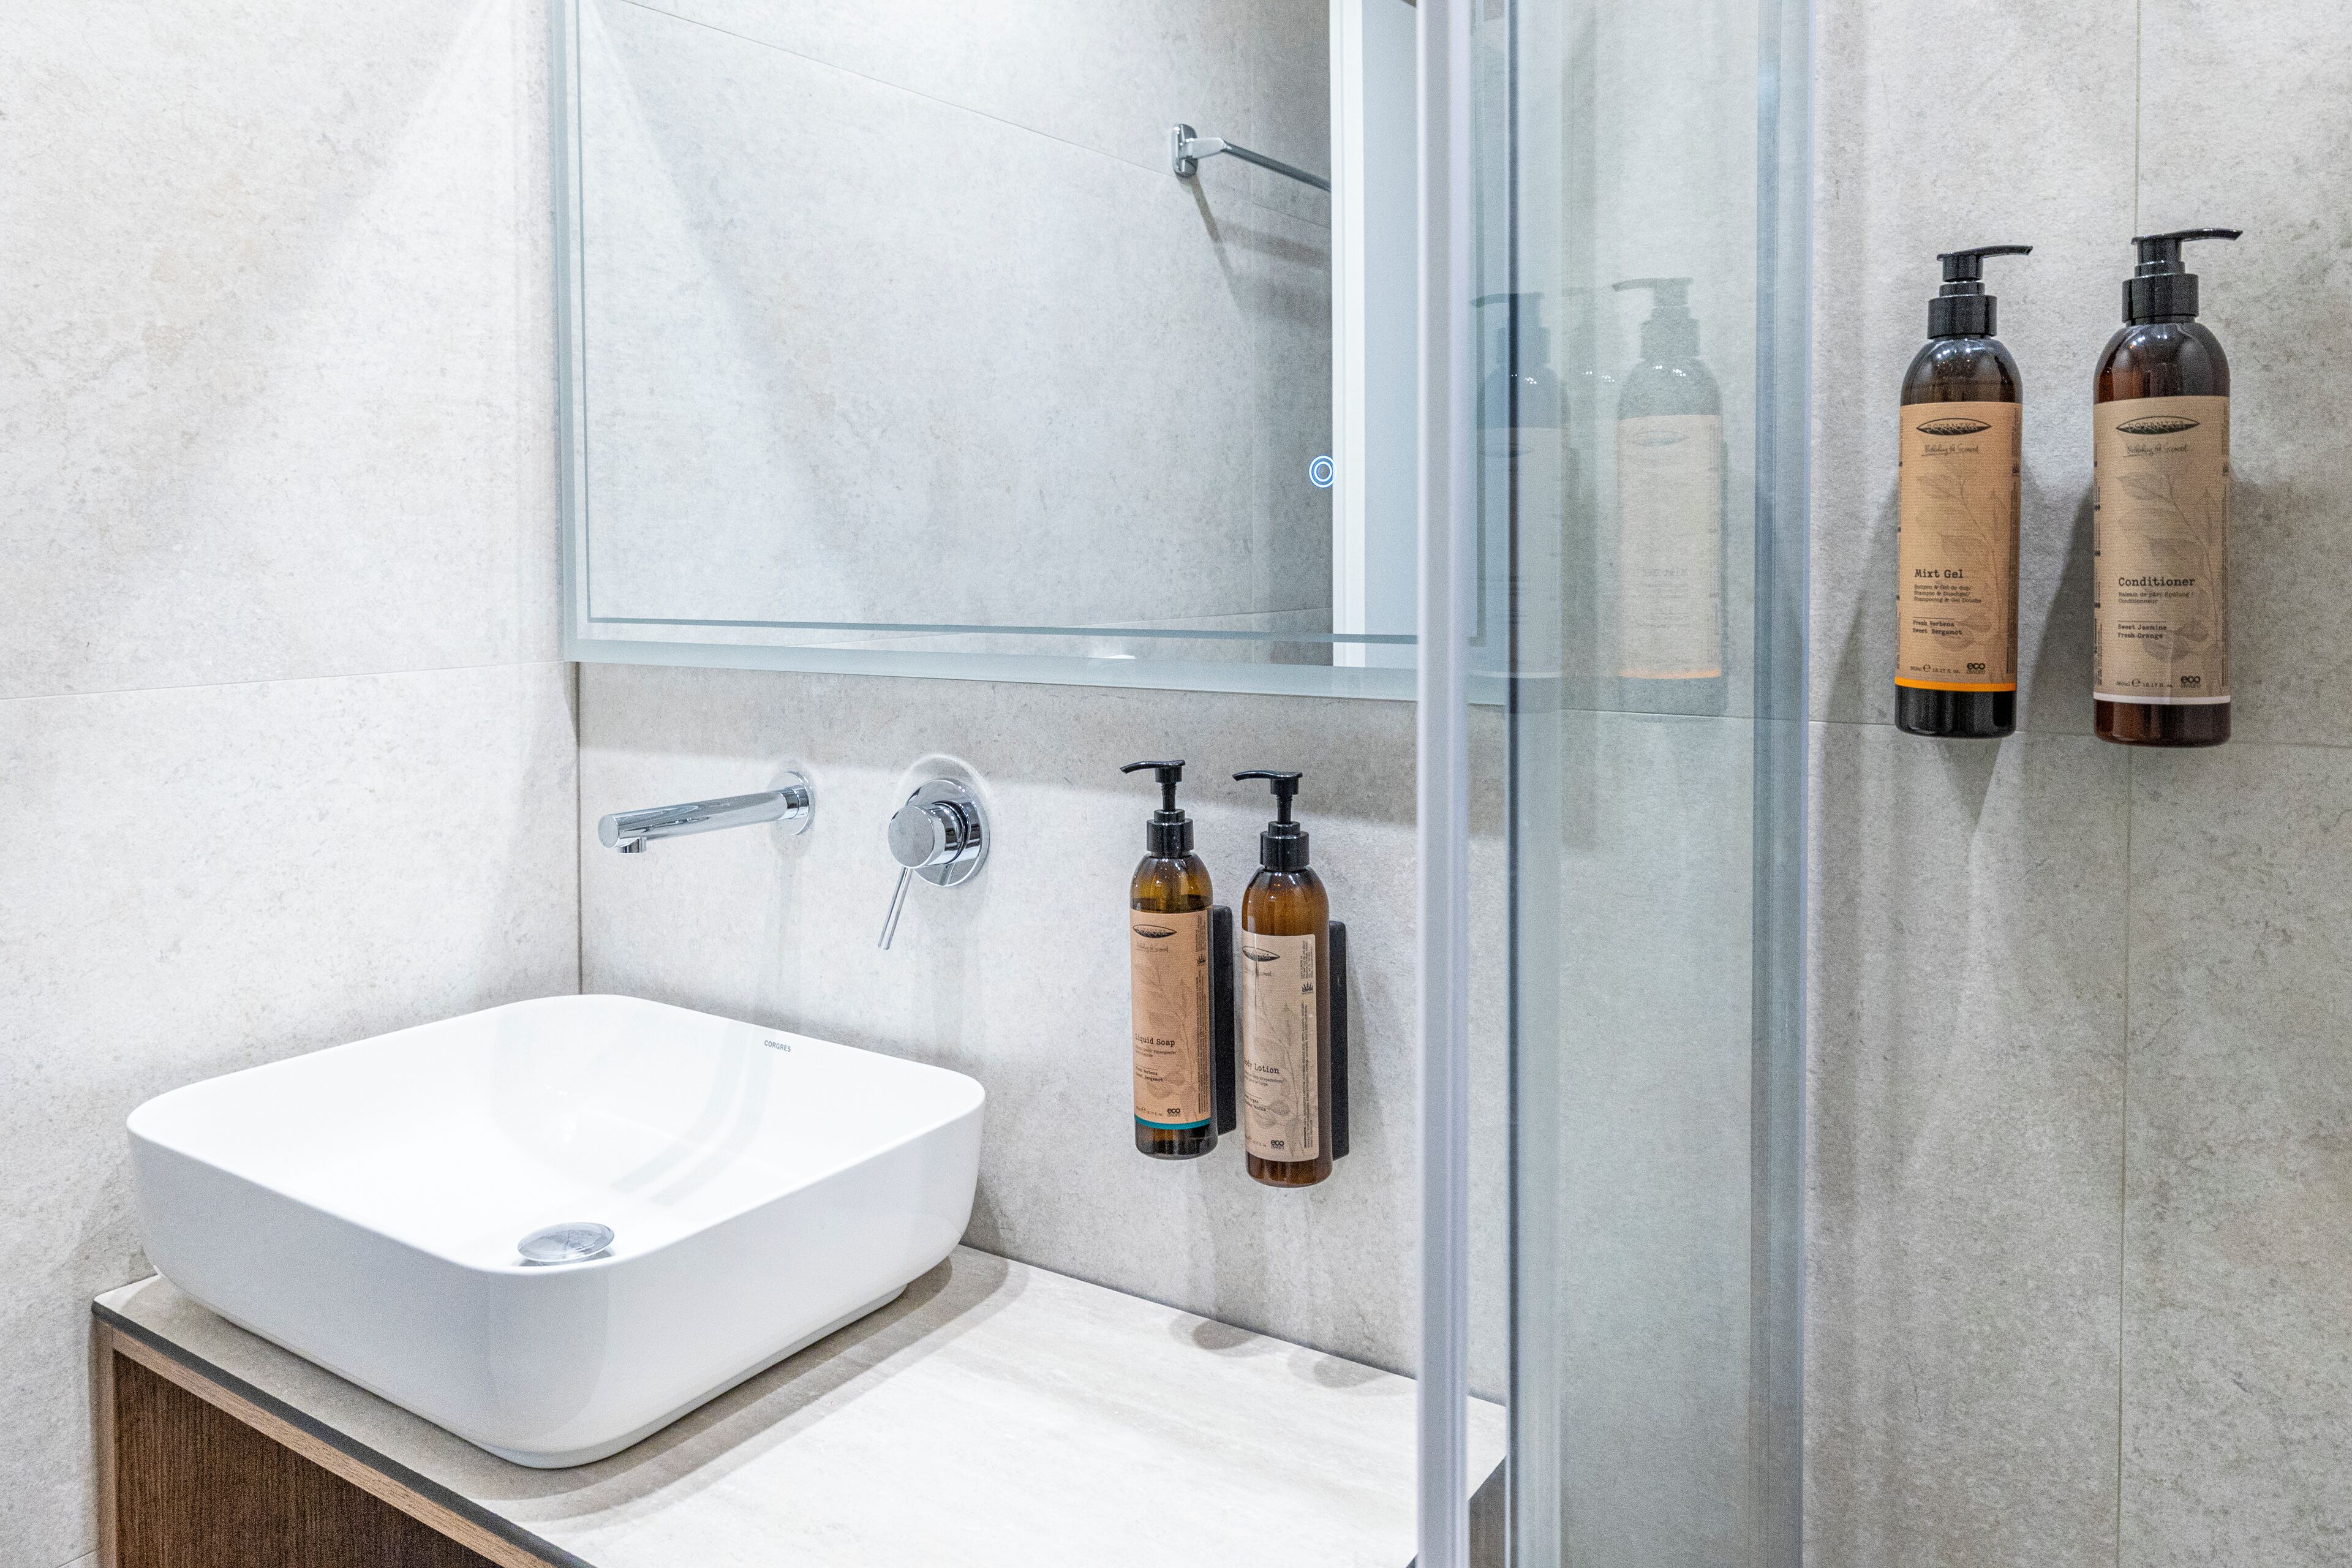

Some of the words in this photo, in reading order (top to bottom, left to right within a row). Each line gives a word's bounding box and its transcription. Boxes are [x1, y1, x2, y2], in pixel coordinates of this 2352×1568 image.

[1915, 569, 1940, 578] Mixt
[1943, 570, 1964, 578] Gel
[2118, 576, 2195, 587] Conditioner
[764, 1039, 791, 1052] CORGRES
[1135, 1033, 1154, 1044] Liquid
[1156, 1038, 1175, 1047] Soap
[1254, 1063, 1280, 1074] Lotion
